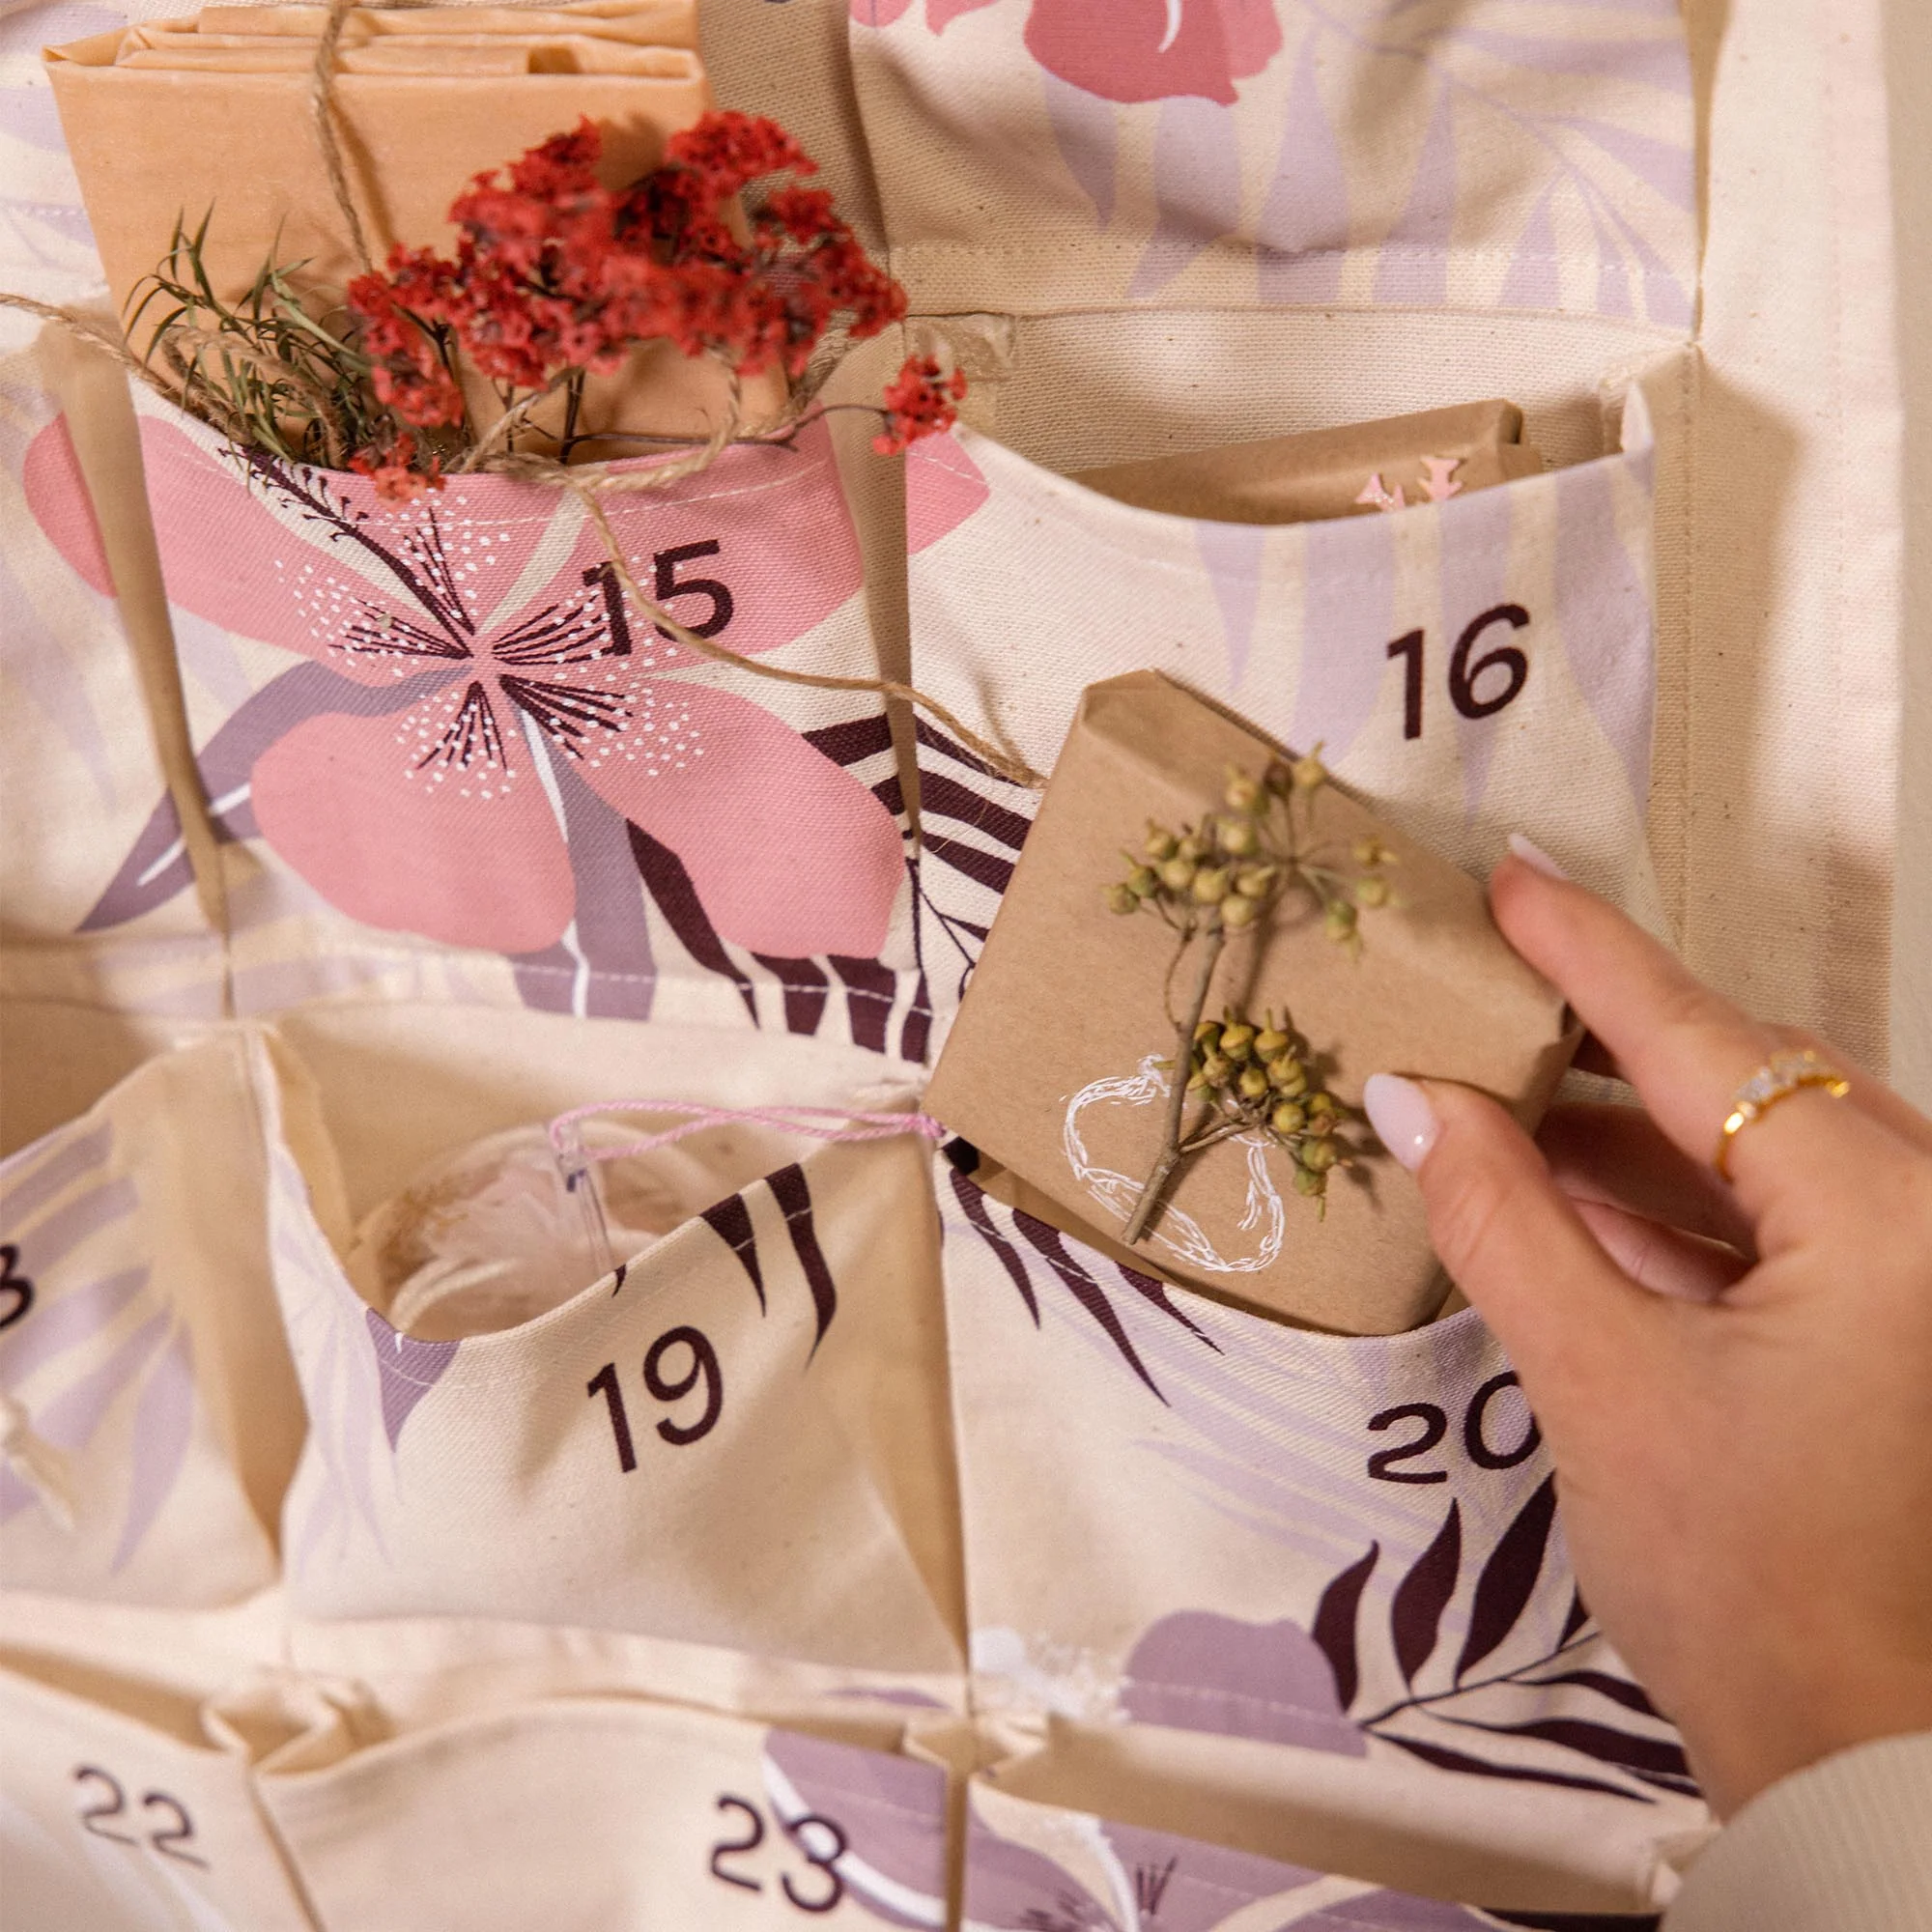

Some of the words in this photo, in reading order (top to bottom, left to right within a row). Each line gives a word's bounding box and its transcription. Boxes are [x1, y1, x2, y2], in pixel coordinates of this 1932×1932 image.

[582, 539, 734, 657] 15
[1386, 603, 1530, 741] 16
[587, 1325, 724, 1473] 19
[1367, 1370, 1542, 1485] 20
[74, 1766, 210, 1868] 22
[710, 1794, 848, 1914] 23
